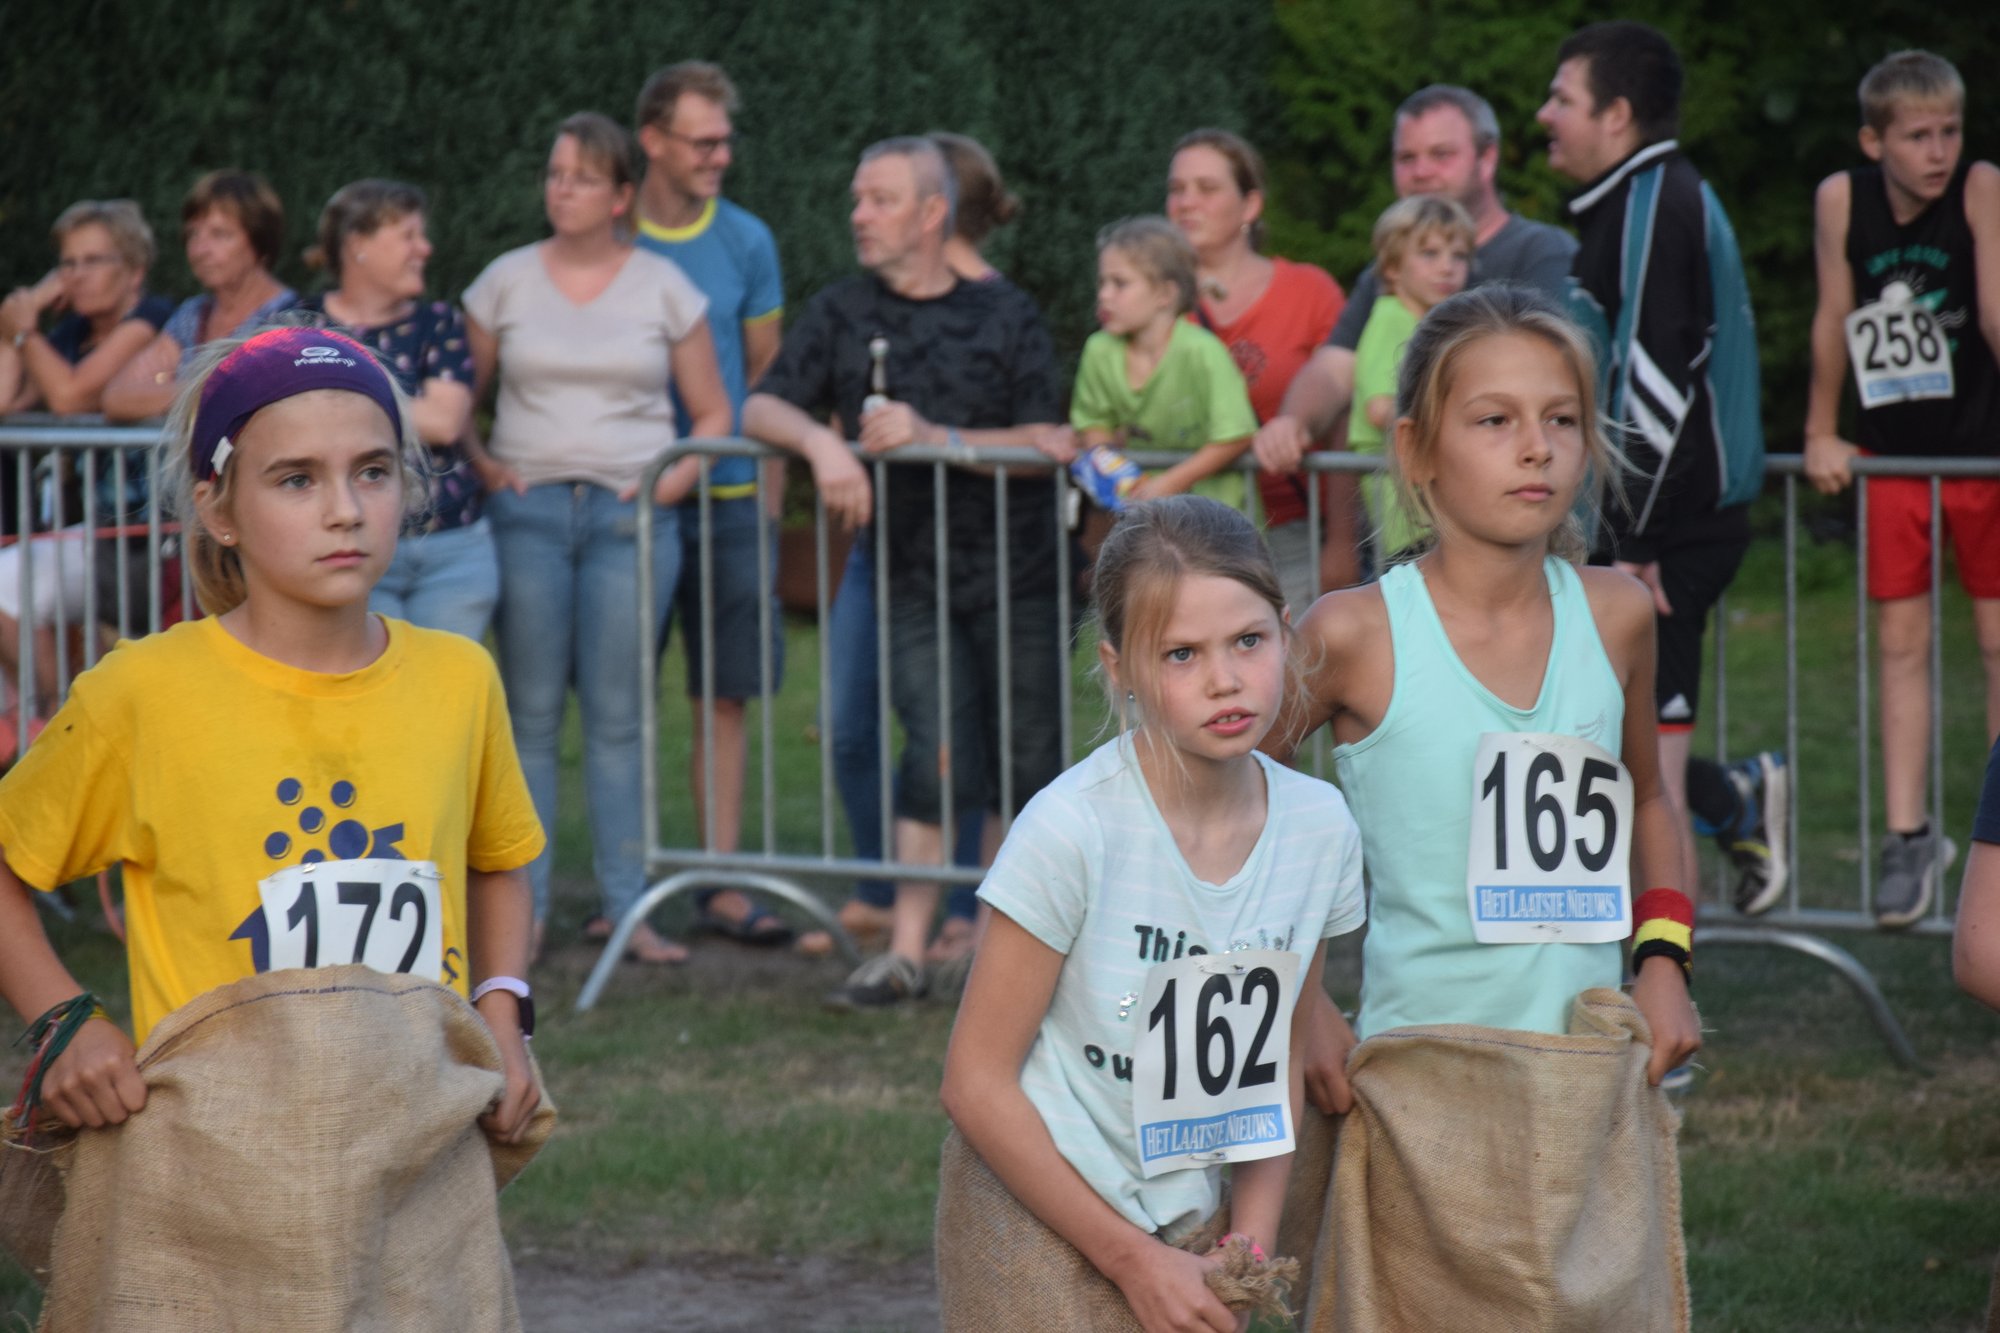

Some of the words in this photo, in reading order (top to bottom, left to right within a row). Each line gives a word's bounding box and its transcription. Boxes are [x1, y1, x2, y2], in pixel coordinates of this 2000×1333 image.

[1856, 311, 1940, 371] 258
[1481, 751, 1619, 872] 165
[287, 881, 427, 974] 172
[1480, 888, 1508, 919] HET
[1509, 889, 1565, 919] LAATSTE
[1566, 889, 1616, 919] NIEUWS
[1148, 966, 1280, 1101] 162
[1145, 1126, 1171, 1157] HET
[1171, 1120, 1226, 1153] LAATSTE
[1225, 1112, 1278, 1143] NIEUWS
